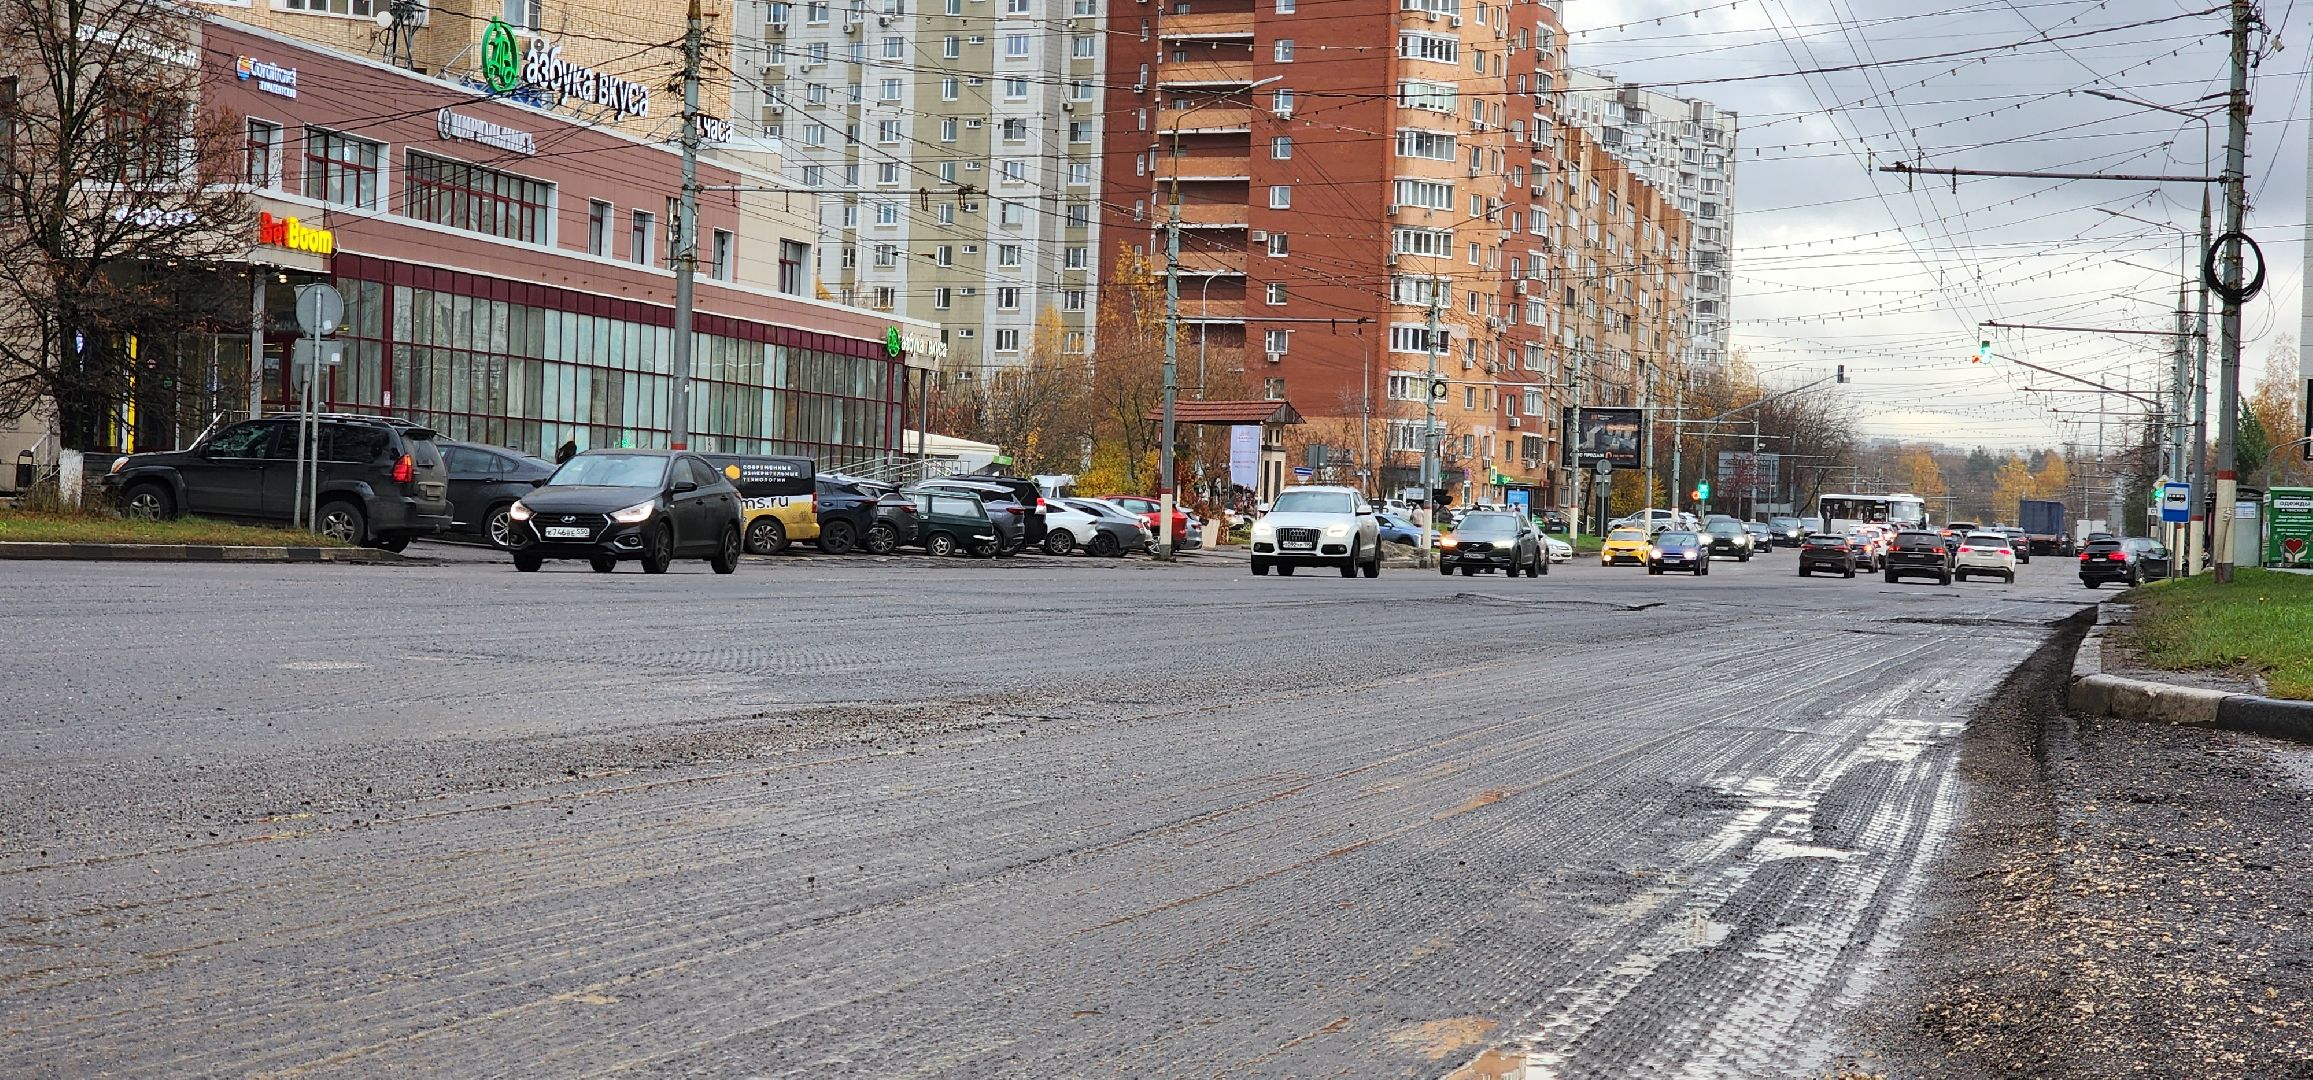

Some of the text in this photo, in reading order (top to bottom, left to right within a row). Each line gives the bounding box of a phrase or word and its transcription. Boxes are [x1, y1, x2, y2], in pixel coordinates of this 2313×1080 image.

[526, 45, 649, 121] азбука вкуса
[703, 116, 733, 144] часа
[259, 211, 333, 254] BetBoom
